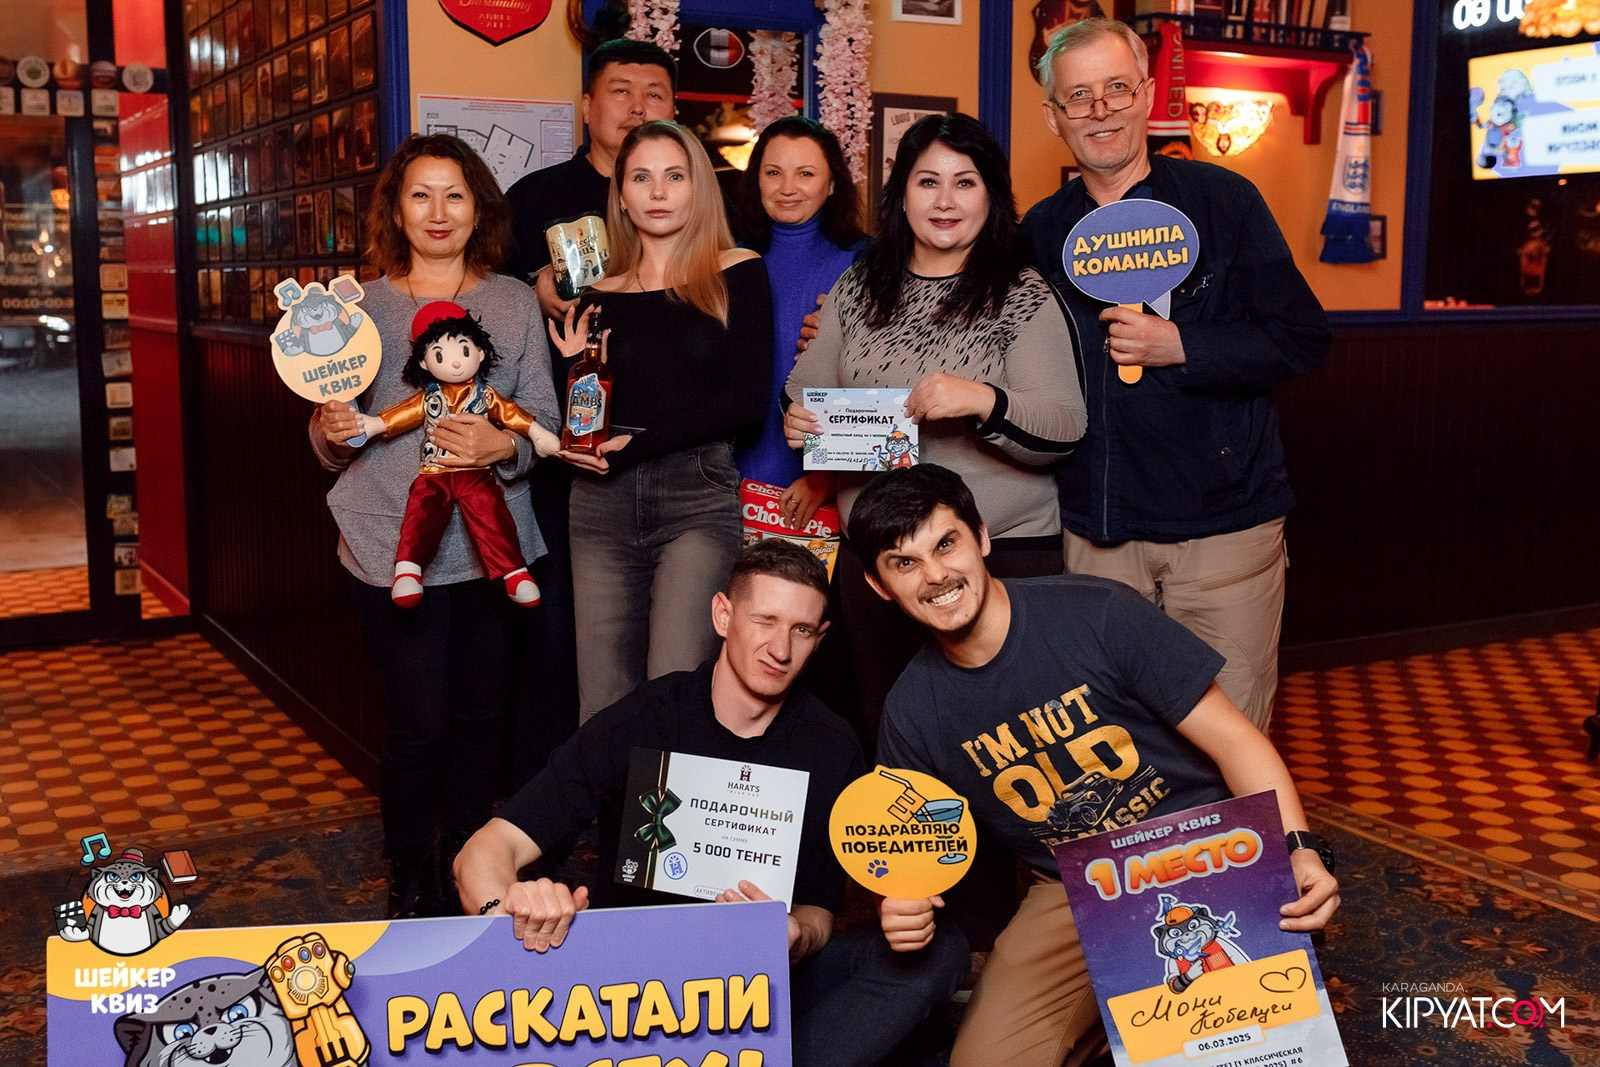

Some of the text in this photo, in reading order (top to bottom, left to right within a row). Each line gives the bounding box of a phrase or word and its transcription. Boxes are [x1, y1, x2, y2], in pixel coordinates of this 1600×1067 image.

[1073, 224, 1185, 256] ДУШНИЛА
[1072, 247, 1188, 277] КОМАНДЫ
[302, 354, 368, 384] ШЕЙКЕР
[319, 374, 362, 397] КВИЗ
[828, 414, 895, 425] СЕРТИФИКАТ
[746, 483, 782, 497] Choc
[803, 519, 833, 538] Pie
[961, 683, 1099, 777] I'M NOT
[992, 724, 1140, 823] OLD
[689, 797, 794, 824] ПОДАРОЧНЫЙ
[1078, 776, 1171, 839] ASSIC
[704, 817, 777, 836] СЕРТИФИКАТ
[845, 823, 960, 837] ПОЗДРАВЛЯЮ
[1110, 813, 1222, 850] ШЕЙКЕР КВИЗ
[692, 842, 782, 867] 5 000 ТЕНГЕ
[841, 836, 968, 855] ПОБЕДИТЕЛЕЙ
[1088, 830, 1260, 898] 1 МЕСТО
[386, 973, 771, 1057] РАСКАТАЛИ
[1131, 994, 1222, 1028] Мони
[1198, 1033, 1251, 1051] 06.03.2025
[1244, 1046, 1304, 1066] КЛАССИЧЕСКАЯ
